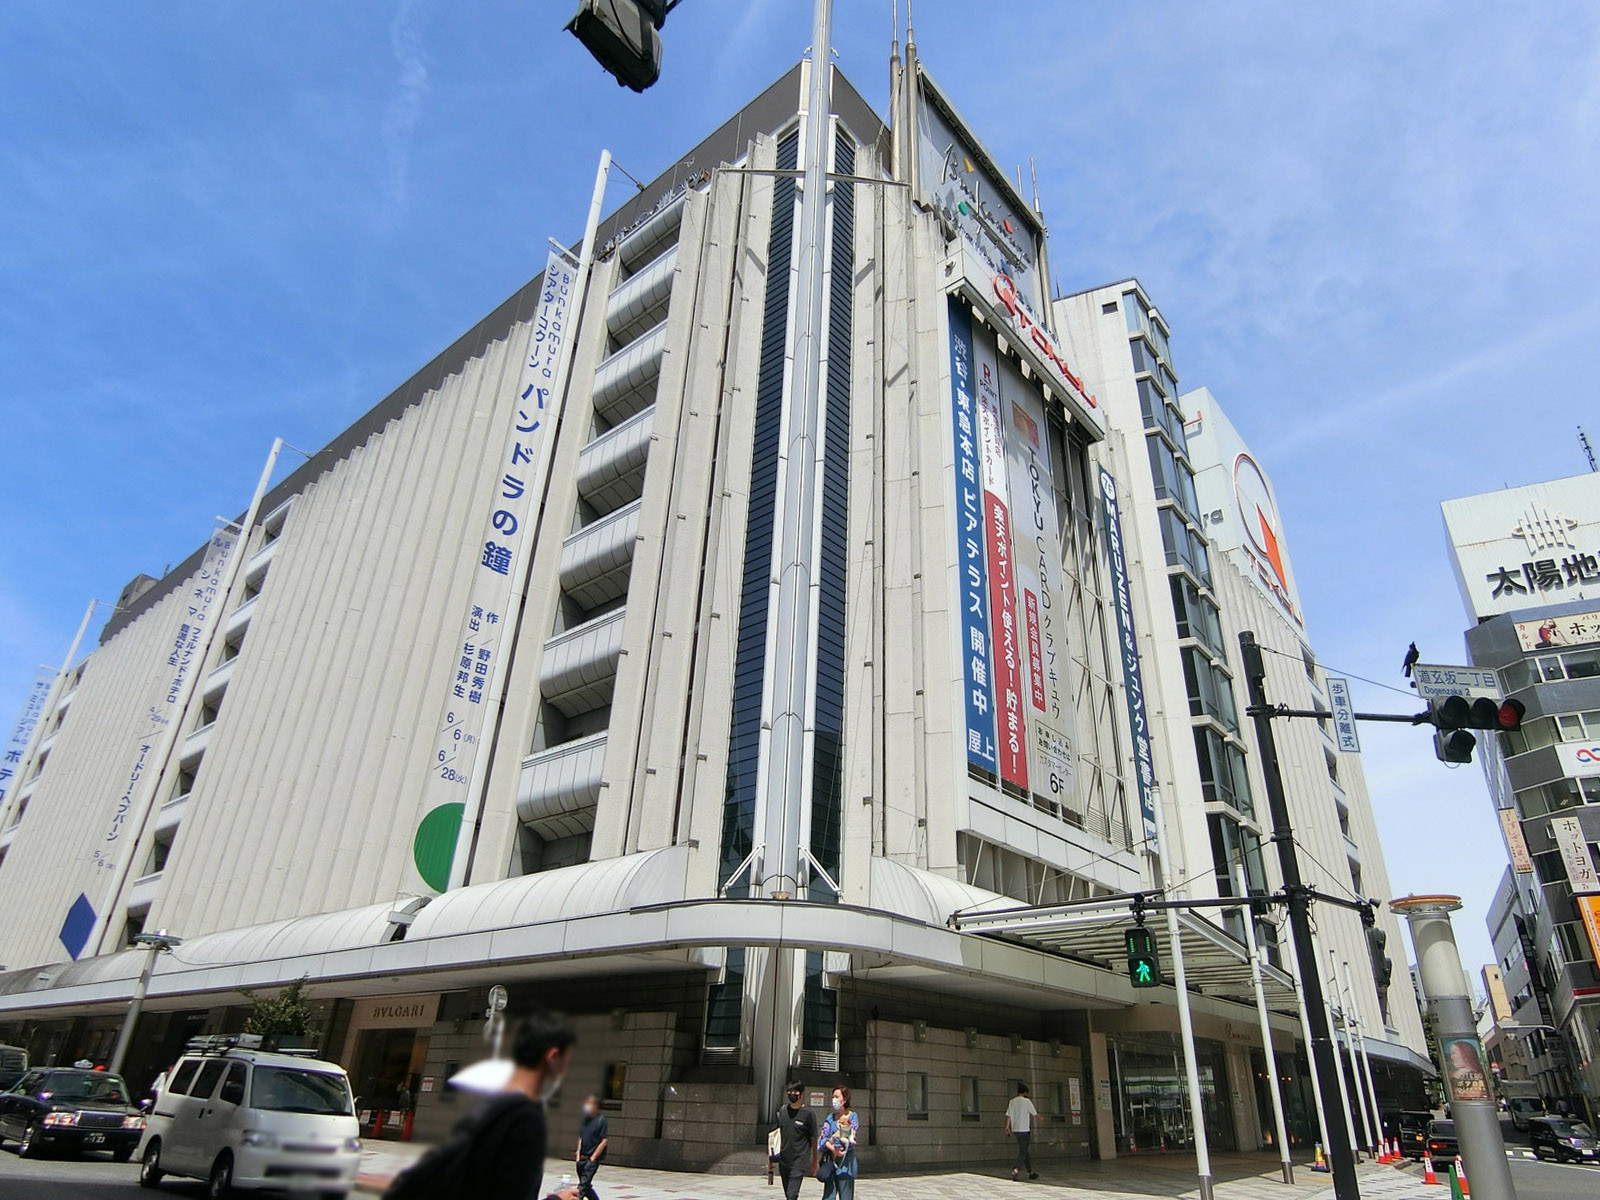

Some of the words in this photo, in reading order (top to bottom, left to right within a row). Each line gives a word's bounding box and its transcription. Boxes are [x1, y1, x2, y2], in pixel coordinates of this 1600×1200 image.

[528, 264, 560, 369] シアターコクーン
[541, 273, 570, 379] Bunkamura
[1014, 304, 1097, 408] TOKYU
[953, 334, 975, 484] 渋谷・東急本店
[481, 383, 550, 576] パンドラの鐘
[1028, 446, 1044, 531] TOKYU
[197, 541, 231, 622] Bunkamura
[963, 487, 983, 619] ビアテラス
[1035, 536, 1051, 609] CARD
[1105, 497, 1131, 630] MARUZEN
[1486, 551, 1600, 598] 太陽地
[970, 625, 988, 716] 開催中
[1418, 670, 1496, 687] 道玄坂二丁目
[1424, 686, 1462, 696] Dogenzaka
[1465, 688, 1471, 696] 2
[968, 728, 995, 762] 屋上
[1332, 683, 1355, 748] 歩車分離式
[1563, 820, 1592, 880] ホットヨガ
[373, 1005, 425, 1018] BVLGARI
